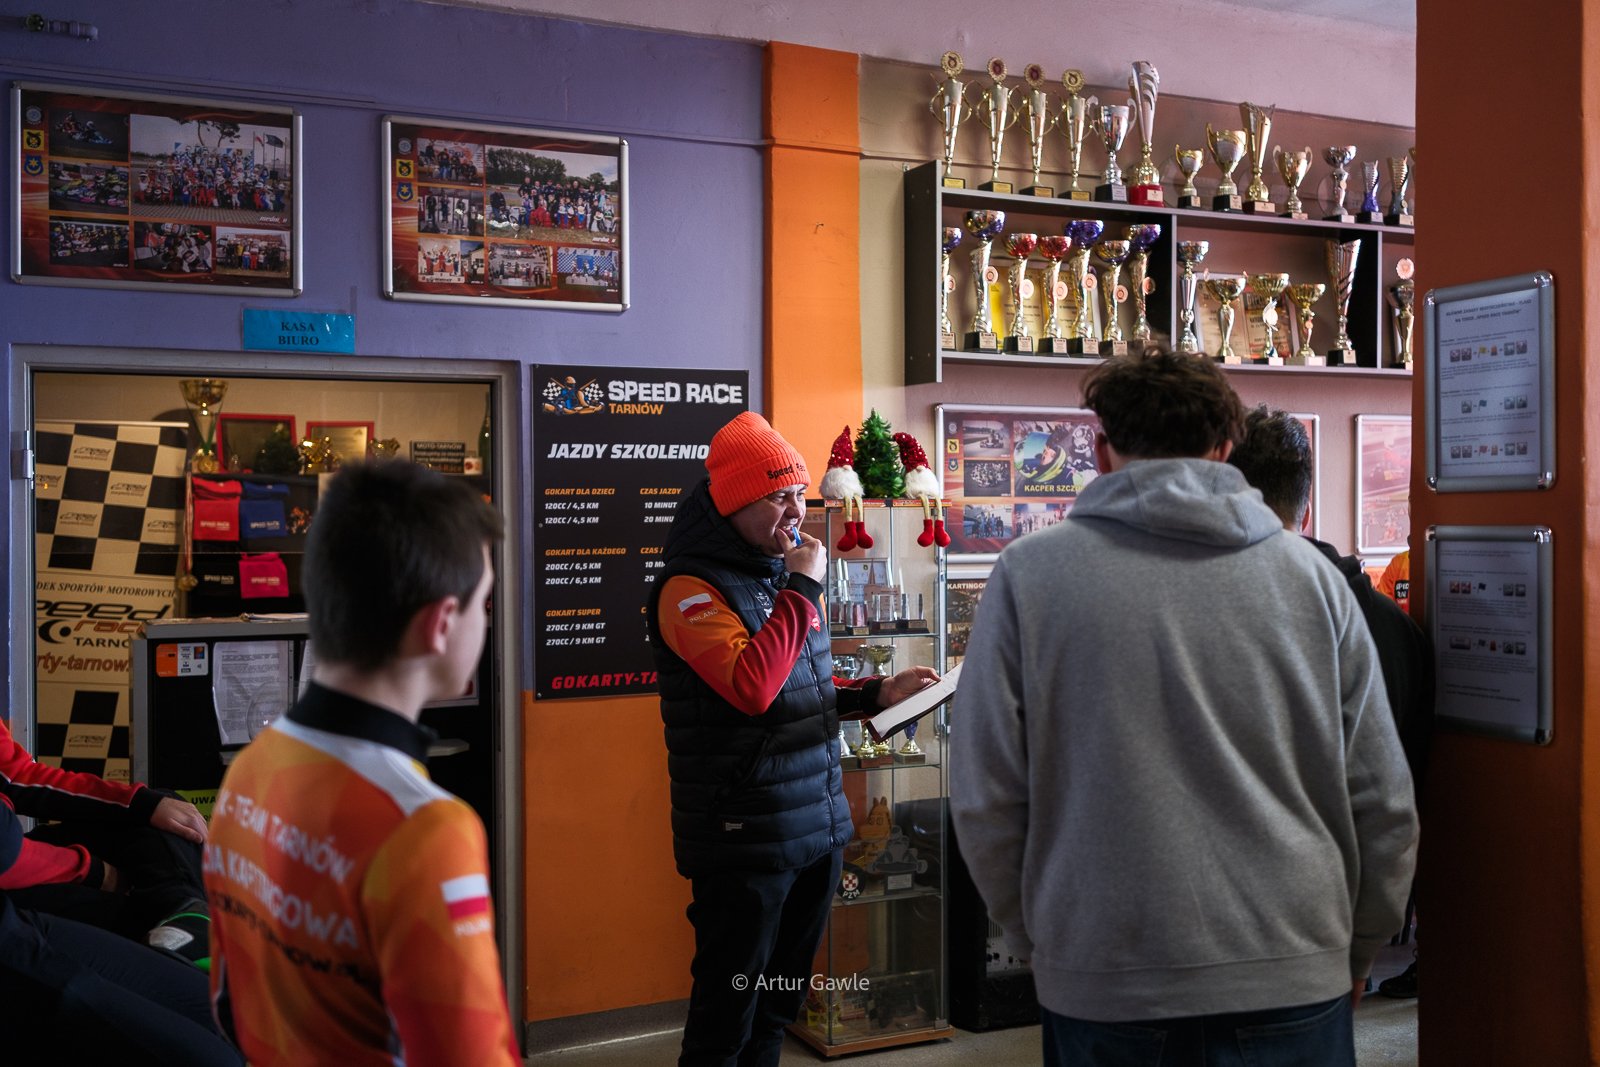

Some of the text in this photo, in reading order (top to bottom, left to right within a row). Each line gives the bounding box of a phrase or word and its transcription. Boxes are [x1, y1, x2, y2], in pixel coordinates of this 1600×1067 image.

[281, 322, 315, 332] KASA
[278, 336, 320, 346] BIURO
[607, 380, 743, 404] SPEED RACE
[609, 403, 664, 415] TARNÓW
[547, 443, 607, 459] JAZDY
[767, 464, 794, 480] Speed
[1024, 484, 1055, 492] KACPER
[545, 502, 566, 510] 120CC
[572, 502, 584, 510] 4,5
[572, 517, 584, 525] 4,5
[592, 546, 627, 555] KAŻDEGO
[575, 563, 587, 571] 6,5
[588, 562, 602, 570] KM
[645, 561, 654, 569] 10
[575, 577, 587, 585] 6,5
[57, 582, 105, 593] SPORTÓW
[106, 588, 176, 598] MOTOROWYCH
[577, 608, 601, 616] SUPER
[688, 607, 719, 624] POLAND
[842, 889, 860, 899] PZM
